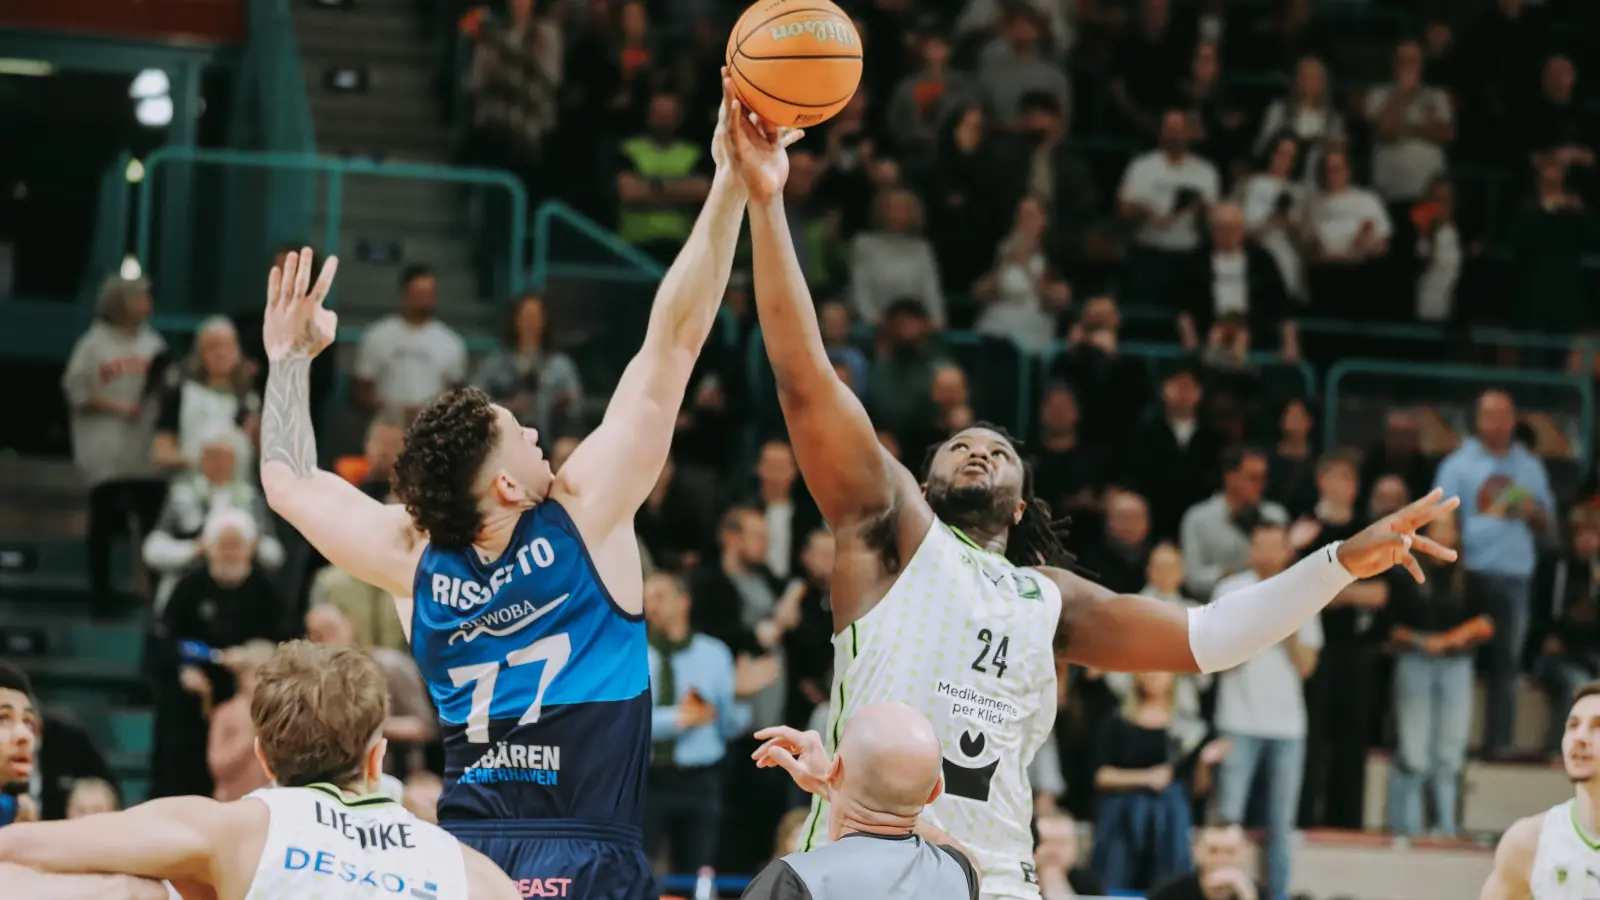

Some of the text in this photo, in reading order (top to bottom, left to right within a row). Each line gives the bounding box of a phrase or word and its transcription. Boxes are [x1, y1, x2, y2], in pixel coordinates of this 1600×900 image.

[768, 20, 856, 47] Wilson
[971, 628, 1009, 679] 24
[447, 632, 572, 744] 77
[937, 681, 1018, 717] Medikamente
[952, 703, 1005, 725] per Klick
[464, 741, 560, 774] BÄREN
[457, 767, 558, 785] EMERHAVEN
[513, 877, 573, 898] EAST
